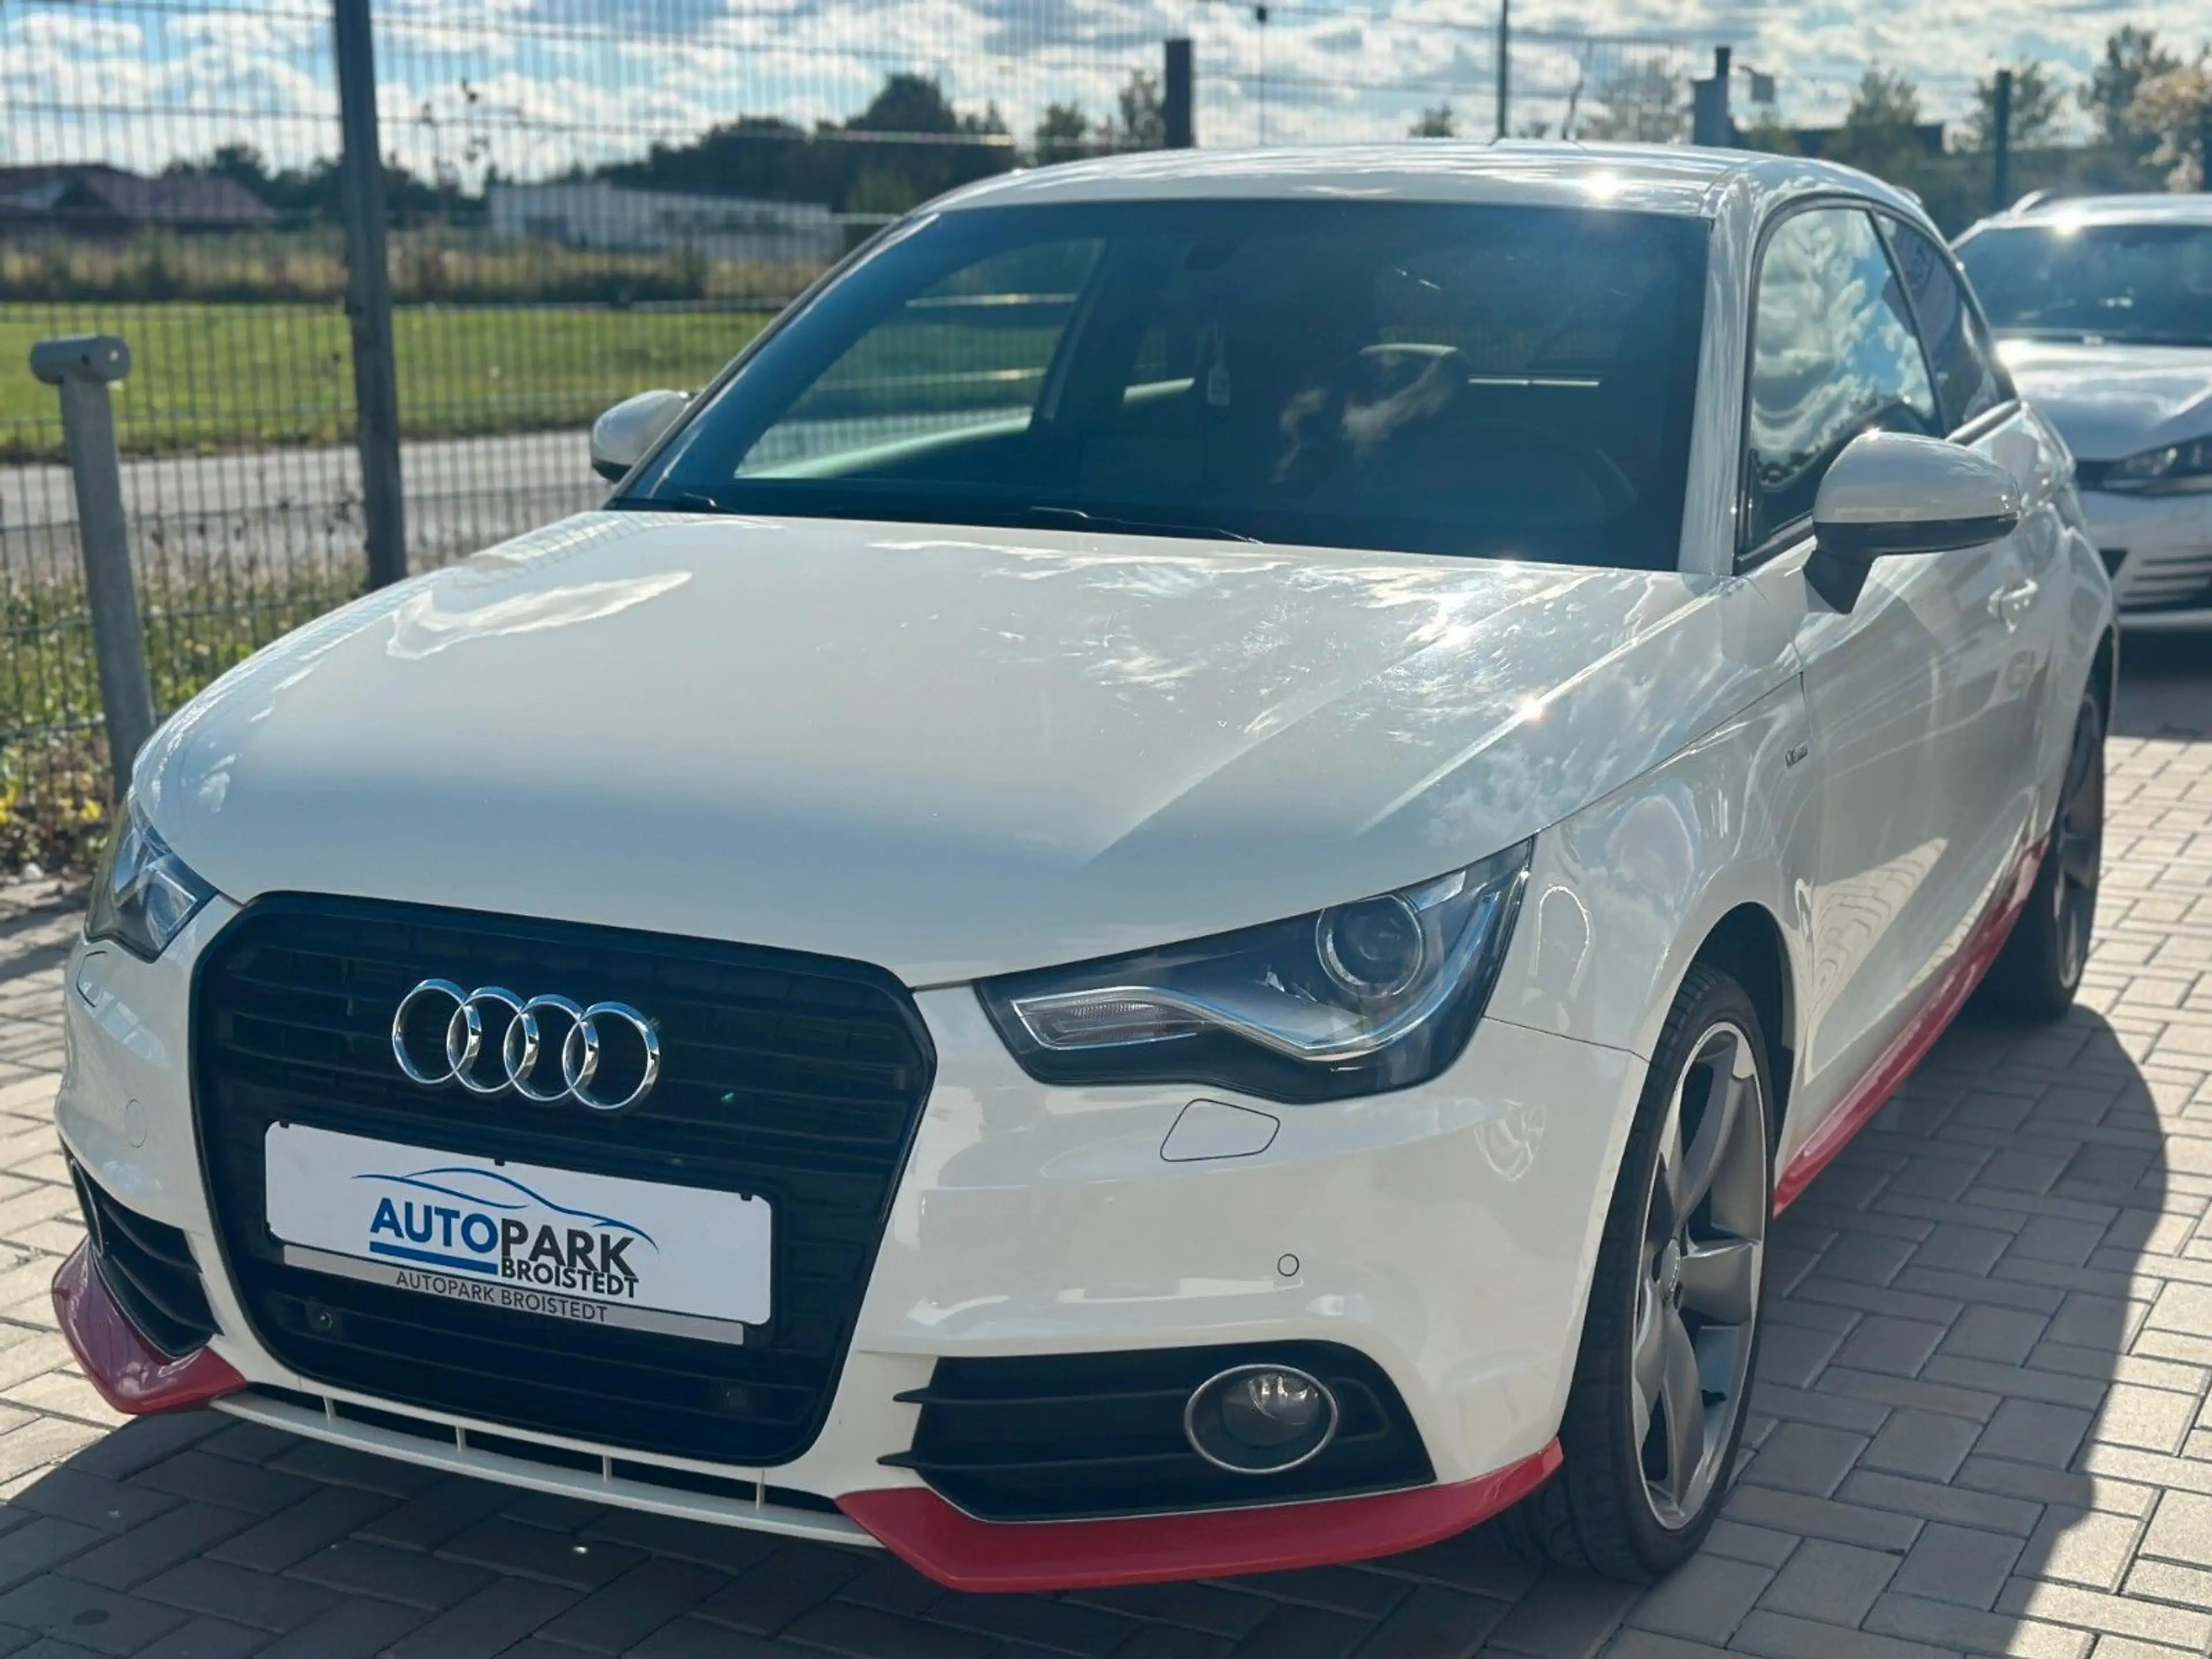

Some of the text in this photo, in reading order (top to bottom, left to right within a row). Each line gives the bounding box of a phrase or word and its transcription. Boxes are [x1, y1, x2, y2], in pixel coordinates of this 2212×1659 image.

[370, 1197, 637, 1277] AUTOPARK
[396, 1270, 608, 1322] AUTOPARK BROISTEDT
[502, 1256, 639, 1298] BROISTEDT
